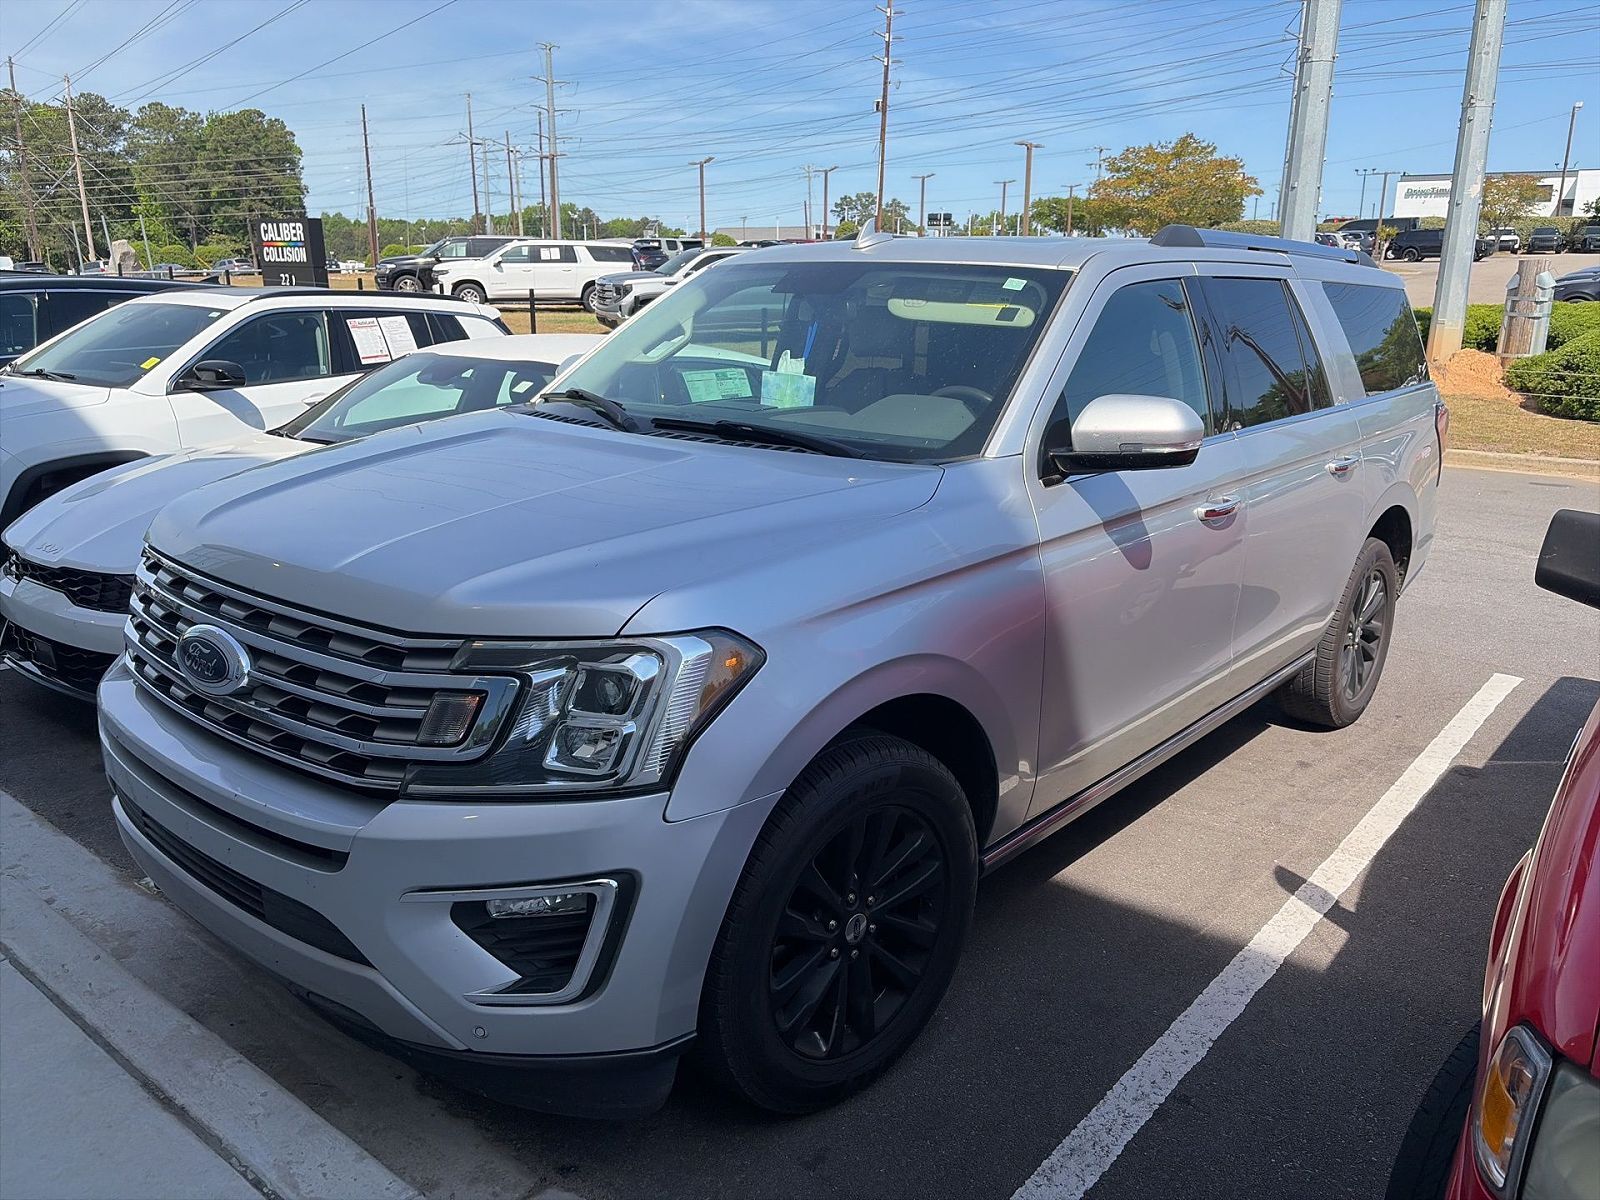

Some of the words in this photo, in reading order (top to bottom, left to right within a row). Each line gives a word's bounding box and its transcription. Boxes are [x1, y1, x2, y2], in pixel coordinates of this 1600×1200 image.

[260, 222, 305, 241] CALIBER
[263, 246, 307, 262] COLLISION
[184, 641, 218, 677] Ford
